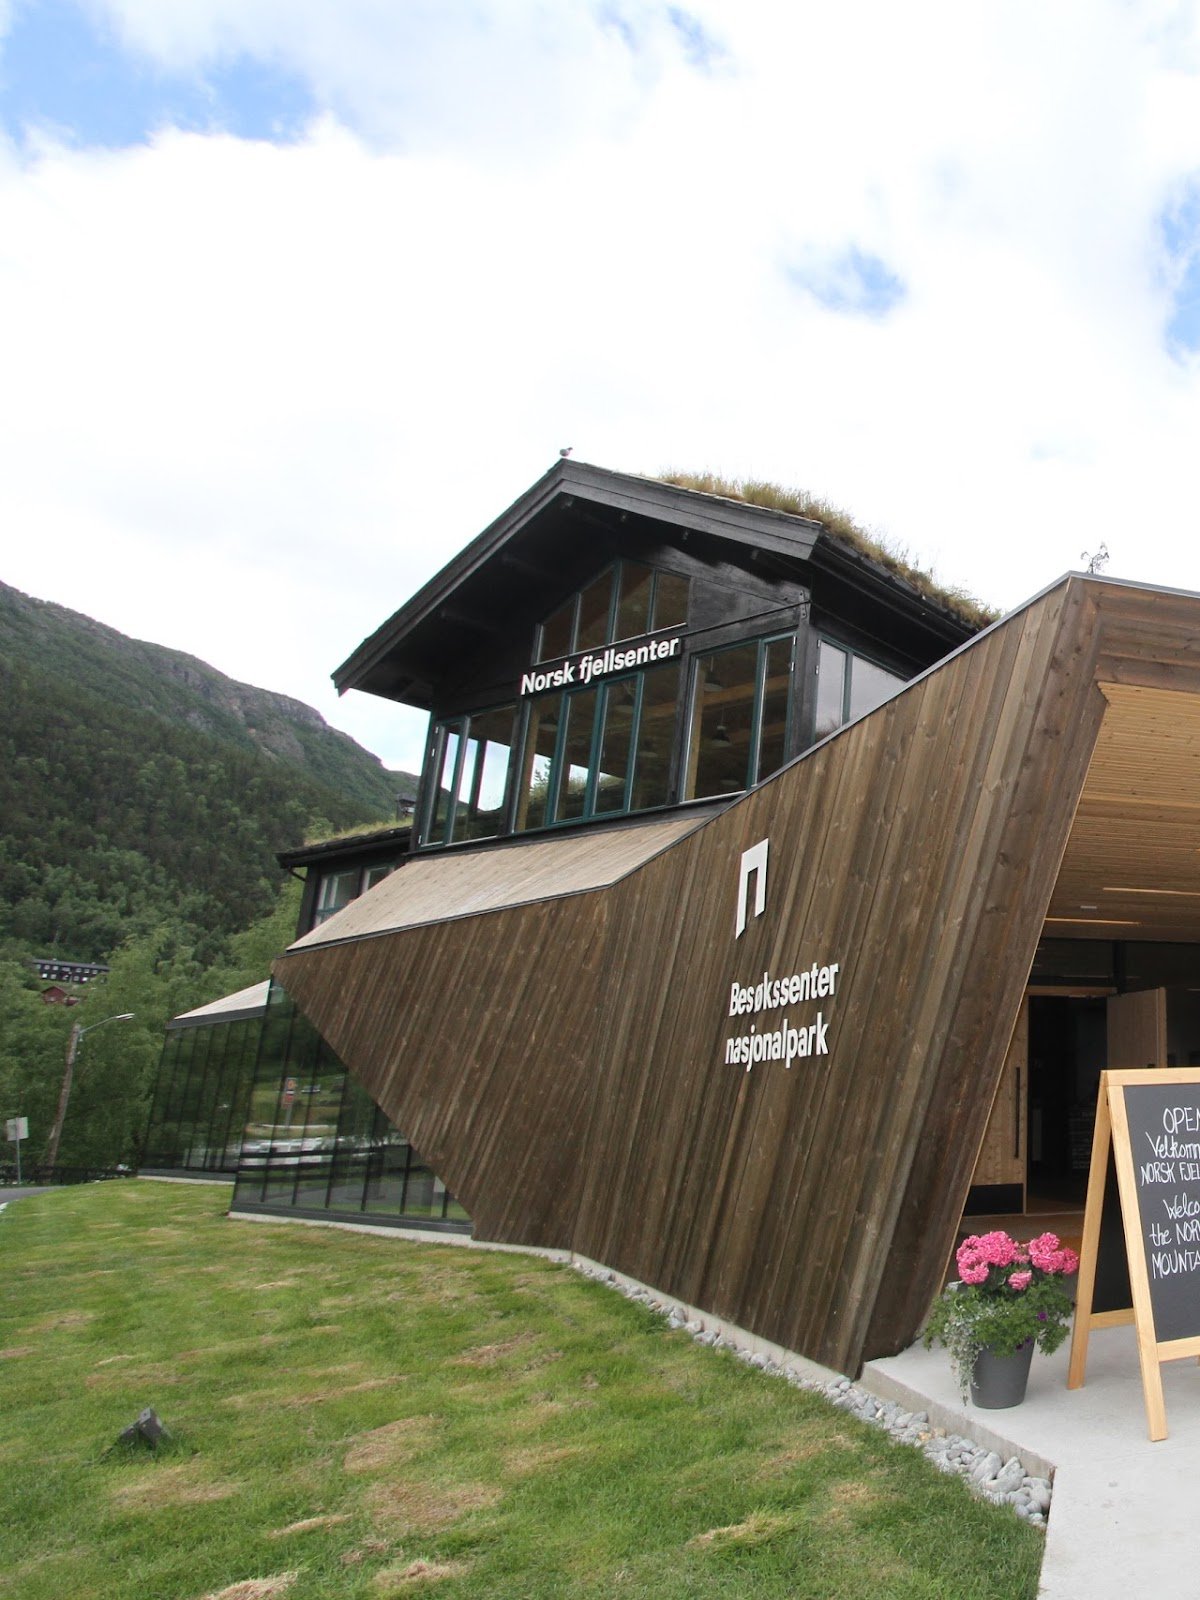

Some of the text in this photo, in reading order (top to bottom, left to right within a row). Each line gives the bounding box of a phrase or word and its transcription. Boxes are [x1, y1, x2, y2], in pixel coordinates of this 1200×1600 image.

[520, 637, 680, 695] Norsk fjellsenter
[728, 962, 839, 1016] Besøkssenter
[725, 1012, 829, 1072] nasjonalpark
[1140, 1162, 1177, 1187] NORSK
[1149, 1220, 1173, 1247] the
